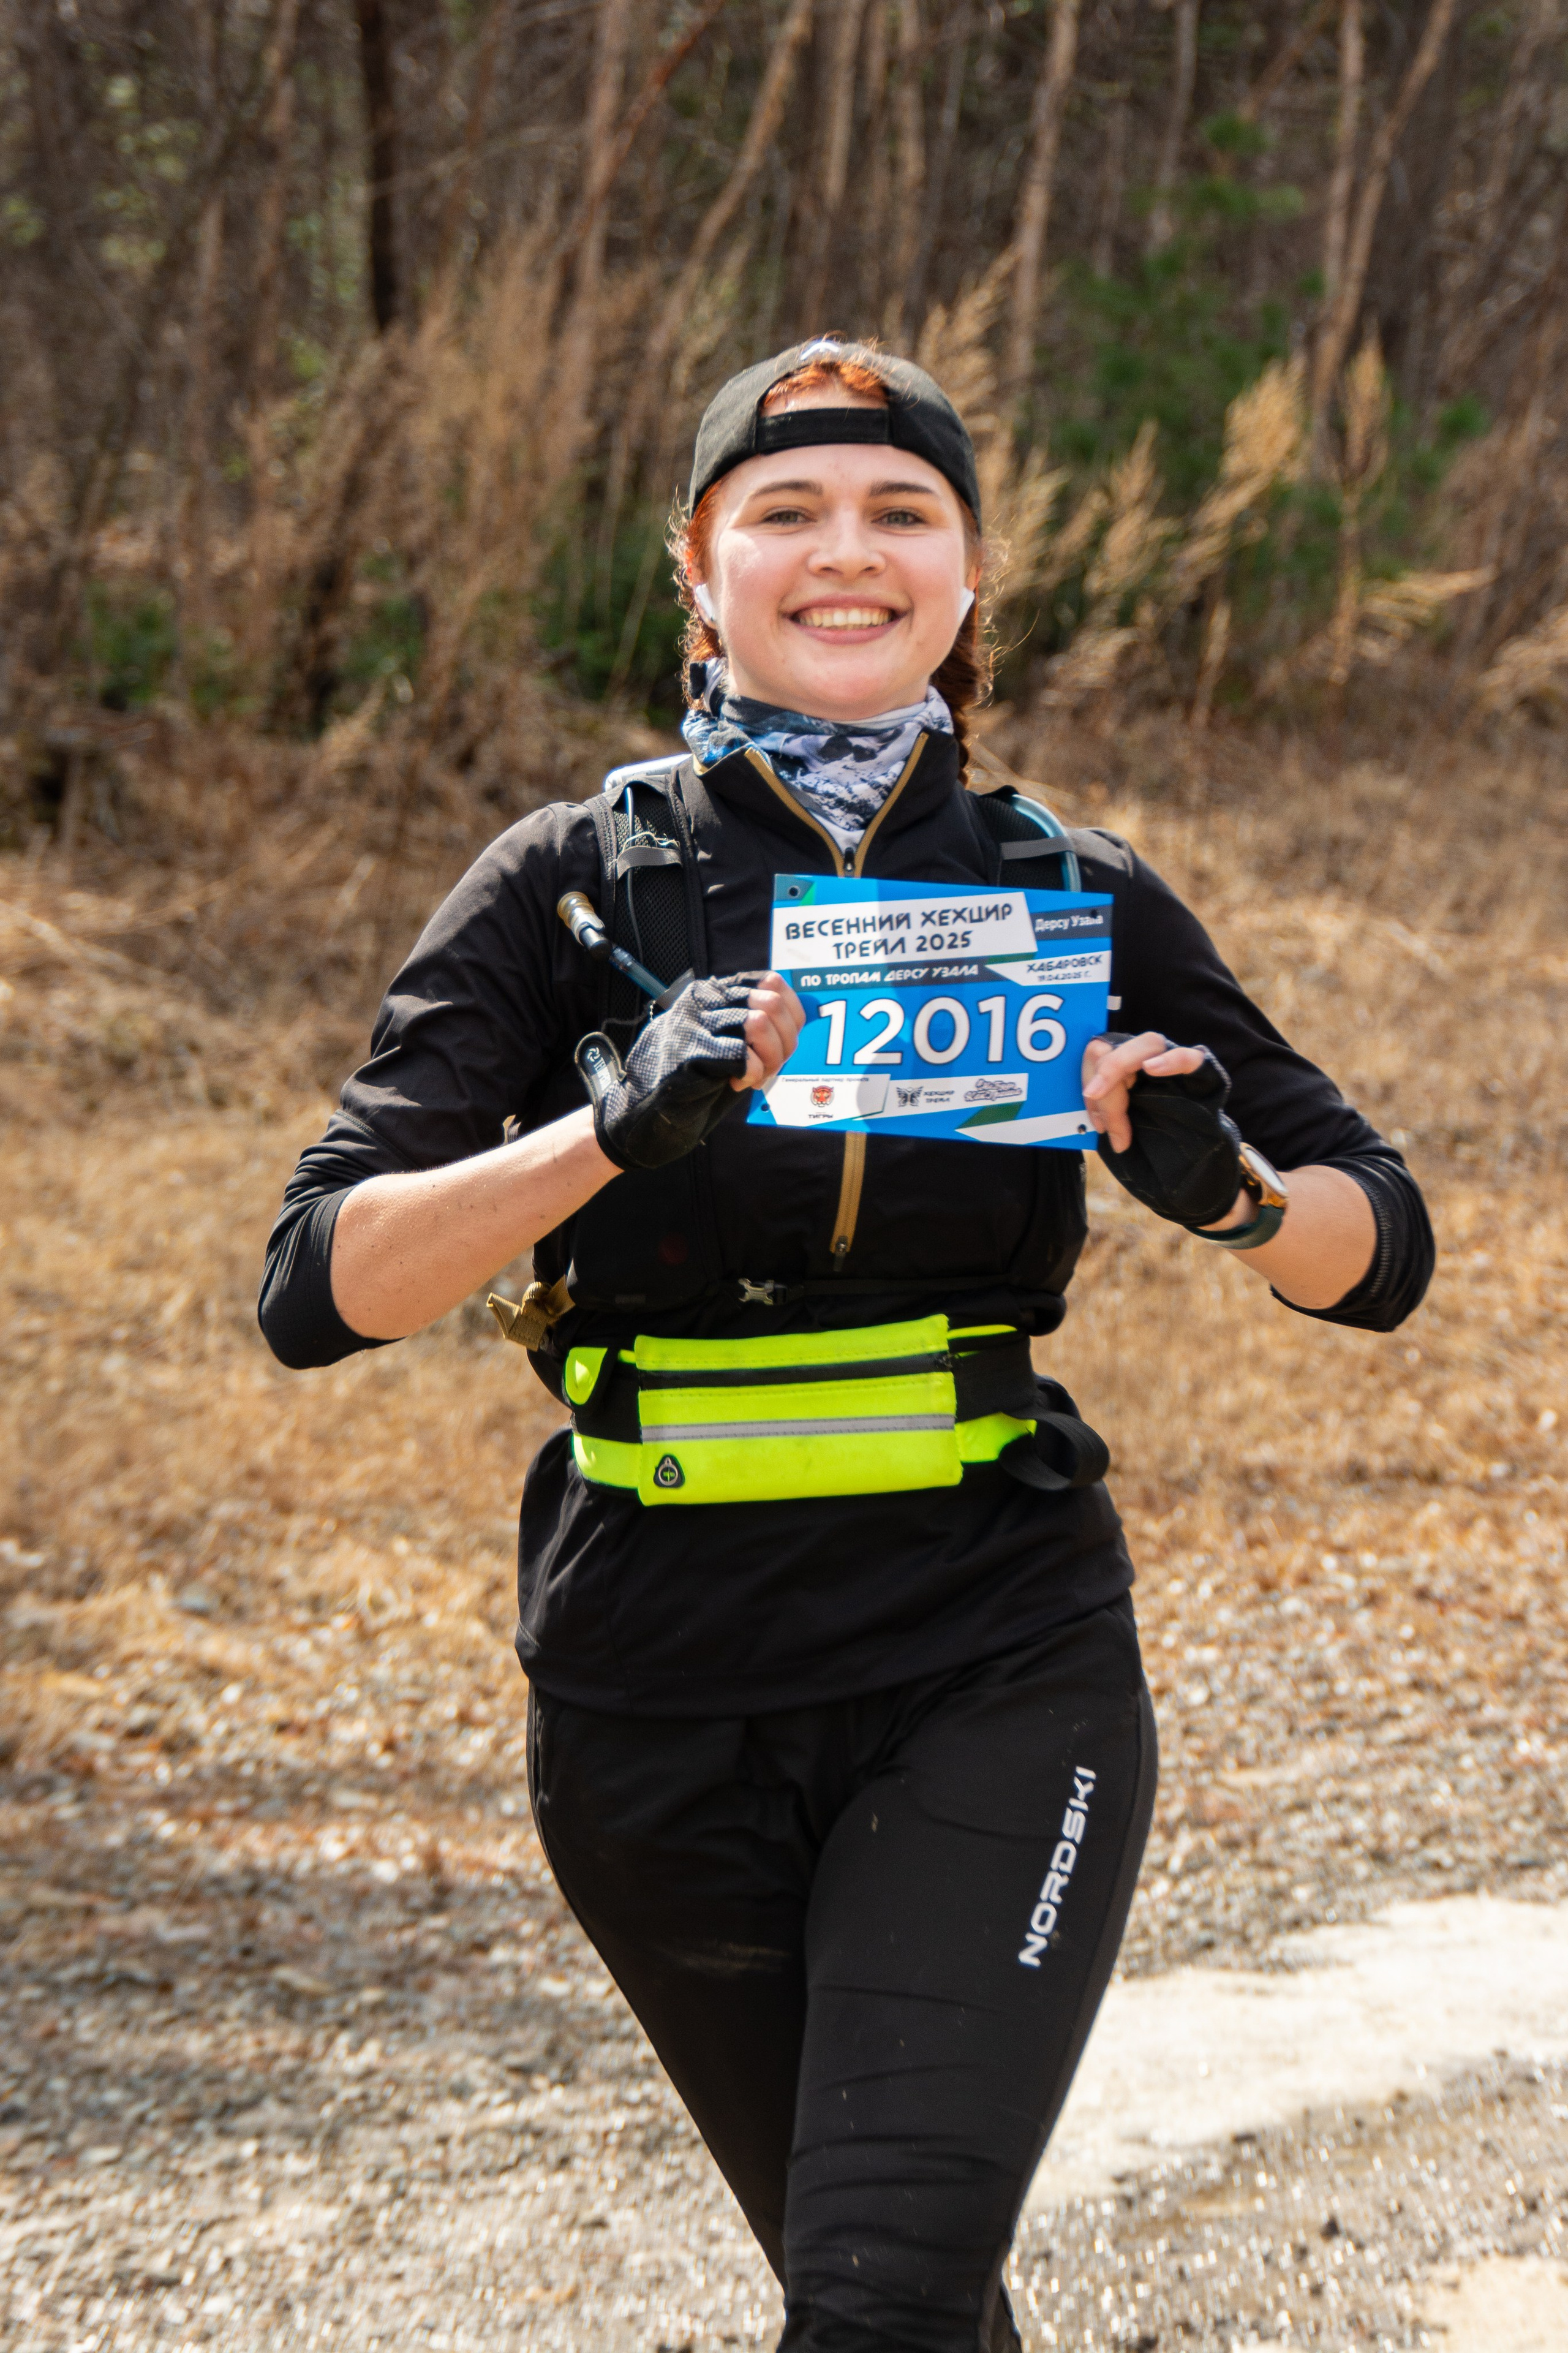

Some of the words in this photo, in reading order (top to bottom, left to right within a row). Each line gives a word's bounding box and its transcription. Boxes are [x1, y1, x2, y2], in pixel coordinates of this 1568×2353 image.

[786, 912, 911, 940] ВЕСЕННИЙ
[921, 903, 1012, 927] ХЕХЦИР
[1035, 918, 1070, 932] Дерсу
[1071, 915, 1104, 927] Узала
[832, 936, 906, 959] ТРЕЙЛ
[915, 930, 973, 953] 2025
[801, 975, 821, 987] ПО
[825, 971, 881, 986] ТРОПАМ
[883, 967, 930, 982] ДЕРСУ
[932, 964, 979, 978] УЗАЛА
[1027, 954, 1102, 973] ХАБАРОВСК
[816, 993, 1066, 1066] 12016
[1017, 1766, 1096, 1968] NORDSKI
